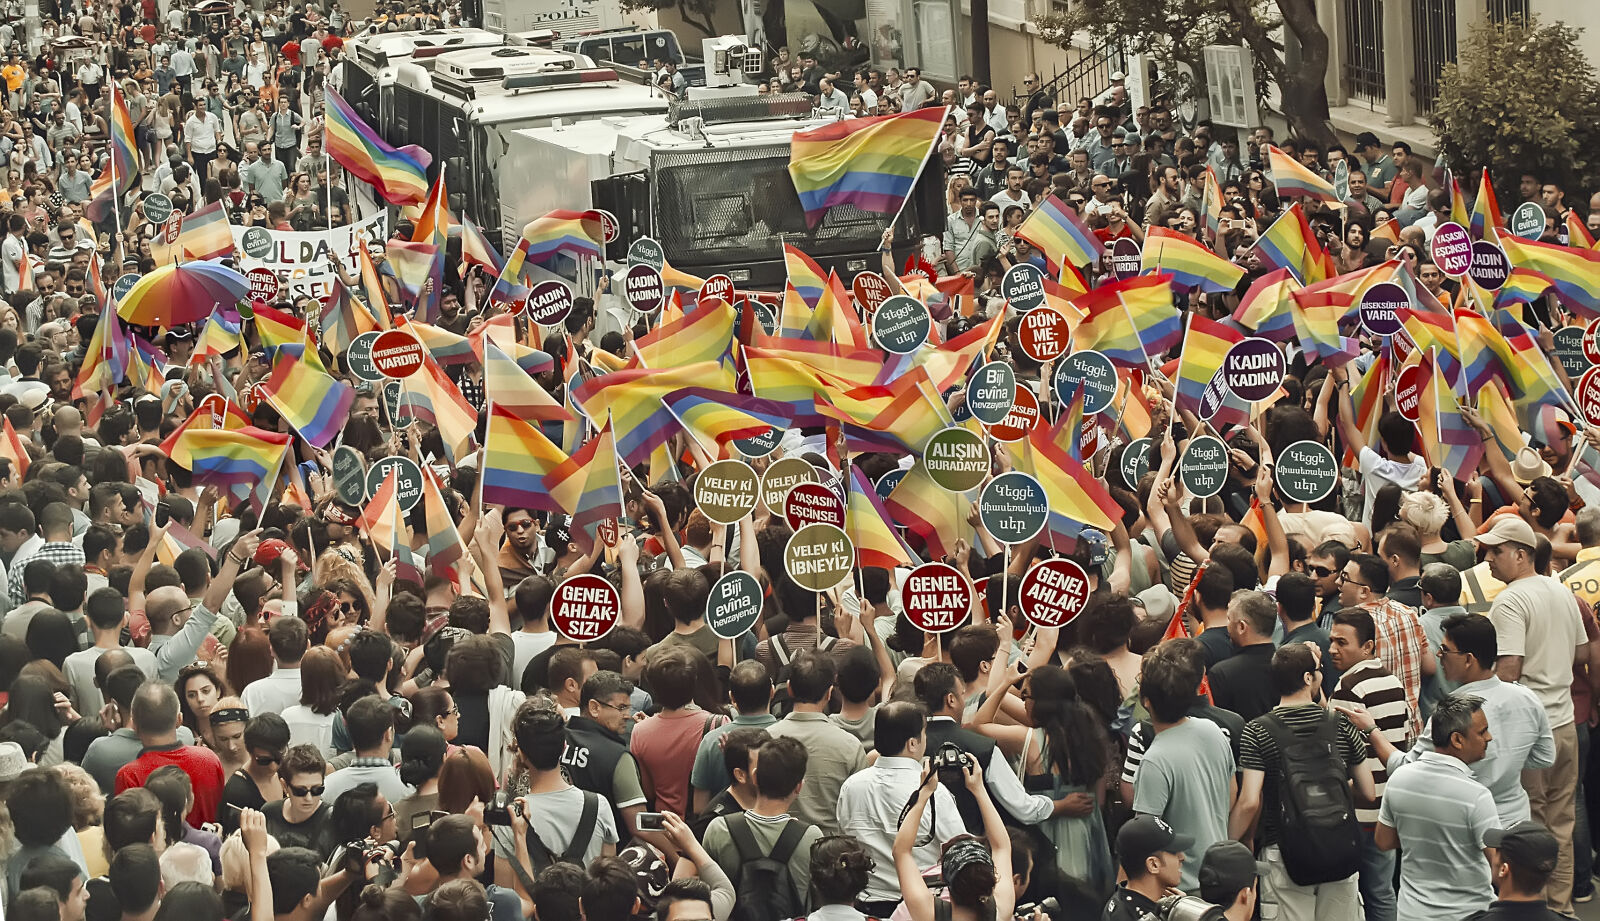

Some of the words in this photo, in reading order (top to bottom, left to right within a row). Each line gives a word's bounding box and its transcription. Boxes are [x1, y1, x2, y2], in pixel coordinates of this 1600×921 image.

[1435, 230, 1465, 245] YAŞASIN
[1444, 256, 1468, 271] AŞK!
[248, 272, 276, 285] GENEL
[627, 274, 659, 290] KADIN
[706, 278, 731, 295] DÖN-
[859, 275, 887, 290] DÖN-
[250, 282, 278, 294] HLAK-
[628, 288, 662, 302] KADINA
[865, 288, 886, 301] ME-
[1009, 281, 1039, 296] evîna
[529, 286, 566, 311] KADIN
[1361, 300, 1409, 310] BİSEKSÜELLER
[532, 298, 571, 322] KADINA
[881, 302, 914, 321] Կեցցե
[1366, 310, 1397, 321] VARD
[1027, 311, 1062, 329] DÖN-
[895, 330, 917, 345] սեր
[1032, 327, 1059, 342] ME-
[1558, 335, 1583, 347] Կեցց
[1032, 341, 1060, 357] YİZ!
[378, 352, 421, 370] VARDIR
[1073, 358, 1108, 378] Կեցցե
[1229, 352, 1278, 371] KADIN
[1562, 358, 1583, 371] սեր
[986, 369, 1005, 386] Bijî
[1228, 371, 1280, 387] KADINA
[976, 385, 1008, 400] evîna
[1010, 404, 1037, 417] EKSLER
[1000, 414, 1031, 430] RDIR
[932, 442, 983, 460] ALIŞIN
[1190, 446, 1220, 460] Կեցցե
[1290, 451, 1325, 465] Կեցցե
[928, 459, 988, 472] BURADAYIZ
[703, 476, 738, 491] VELEV
[740, 478, 753, 492] Kİ
[766, 473, 798, 489] VELEV
[800, 470, 812, 483] Kİ
[1195, 473, 1214, 488] սեր
[1294, 479, 1318, 494] սեր
[397, 487, 419, 500] yendî
[698, 488, 754, 509] İBNEYİZ
[793, 491, 837, 509] YAŞASIN
[995, 484, 1035, 500] Կեցցե
[789, 503, 840, 524] EŞCİNSEL
[981, 501, 1047, 515] միասեռական
[1000, 516, 1026, 534] սեր
[792, 543, 828, 559] VELEV
[831, 538, 844, 553] Kİ
[791, 554, 850, 576] İBNEYİZ
[721, 579, 742, 599] Bijî
[909, 575, 962, 593] GENEL
[1036, 566, 1085, 597] GENEL
[1570, 578, 1599, 594] PO
[561, 585, 613, 605] GENEL
[909, 593, 969, 610] AHLAK-
[1026, 583, 1082, 613] AHLAK-
[558, 602, 616, 622] AHLAK-
[715, 595, 751, 617] evîna
[713, 604, 758, 629] hevzayendî
[921, 610, 954, 627] SIZ!
[1030, 603, 1063, 626] SIZ!
[567, 620, 600, 637] SIZ!
